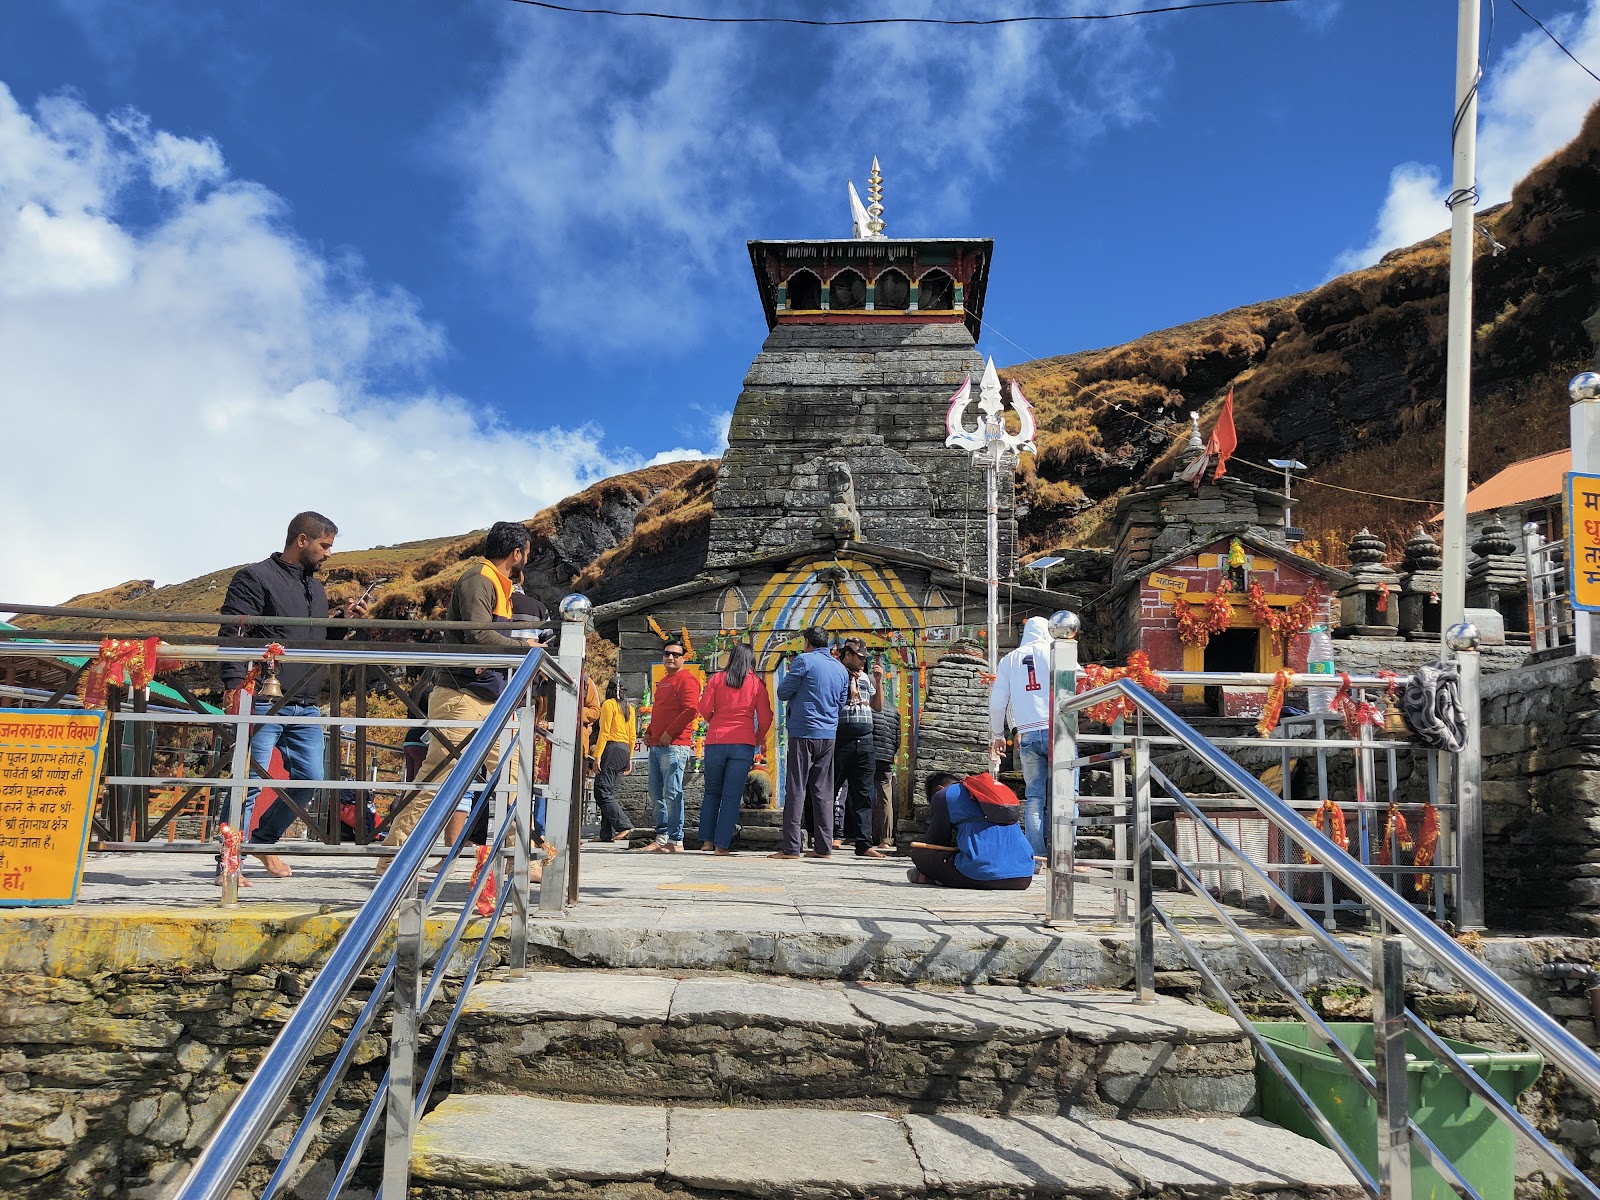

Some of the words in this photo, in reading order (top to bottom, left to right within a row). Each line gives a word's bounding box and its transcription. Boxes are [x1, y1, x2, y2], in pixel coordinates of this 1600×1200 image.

[1022, 654, 1041, 691] 1
[0, 723, 21, 739] जन
[67, 721, 99, 741] विवरण
[6, 752, 28, 766] पूजन
[57, 751, 78, 765] होती
[2, 765, 29, 779] पार्वती
[31, 766, 43, 780] श्री
[46, 767, 70, 781] गणेश
[70, 768, 83, 780] जी
[3, 783, 23, 796] दर्शन
[26, 785, 46, 799] पूजन
[4, 800, 23, 813] करने
[27, 801, 36, 813] के
[39, 803, 57, 814] बाद
[5, 816, 17, 830] श्री
[20, 837, 41, 849] जाता
